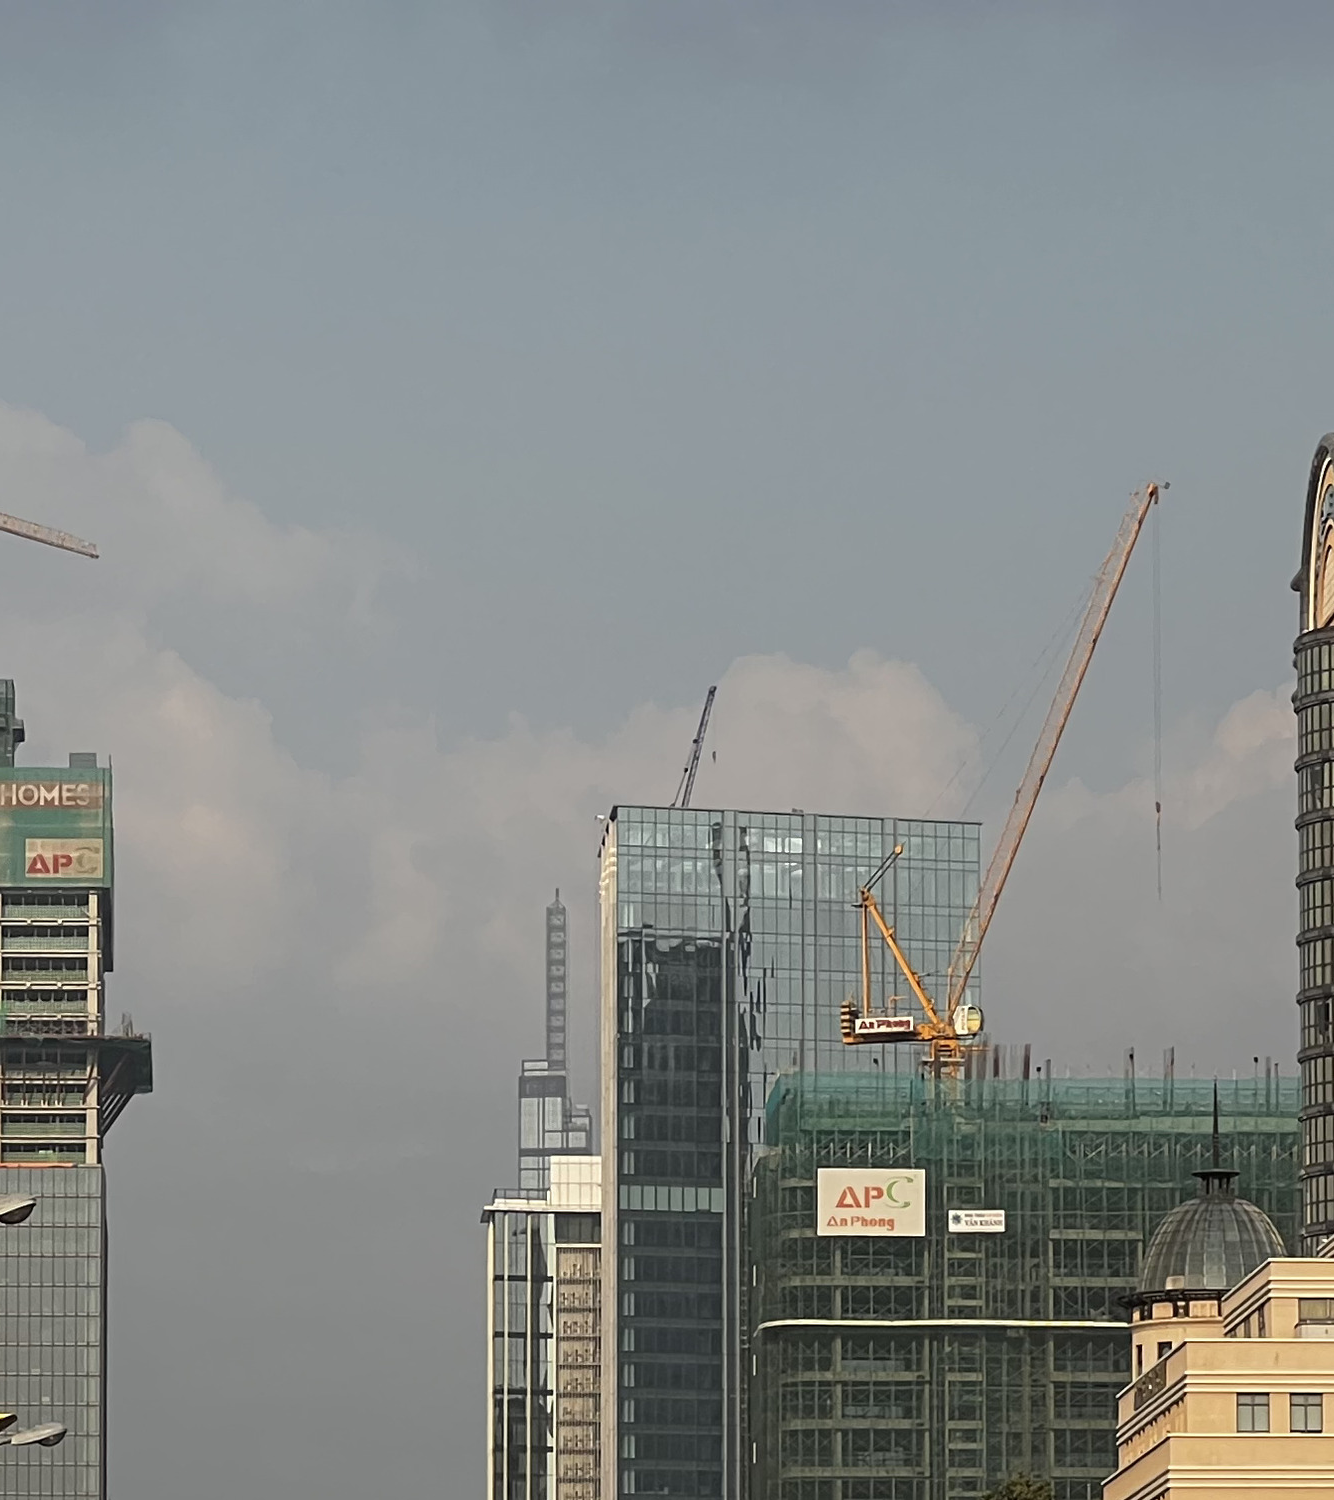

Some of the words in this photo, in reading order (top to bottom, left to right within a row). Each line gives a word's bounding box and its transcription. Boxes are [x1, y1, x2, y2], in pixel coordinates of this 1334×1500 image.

[0, 784, 89, 806] HOMES
[835, 1176, 914, 1209] APC
[827, 1216, 848, 1227] An
[851, 1216, 895, 1231] Phong
